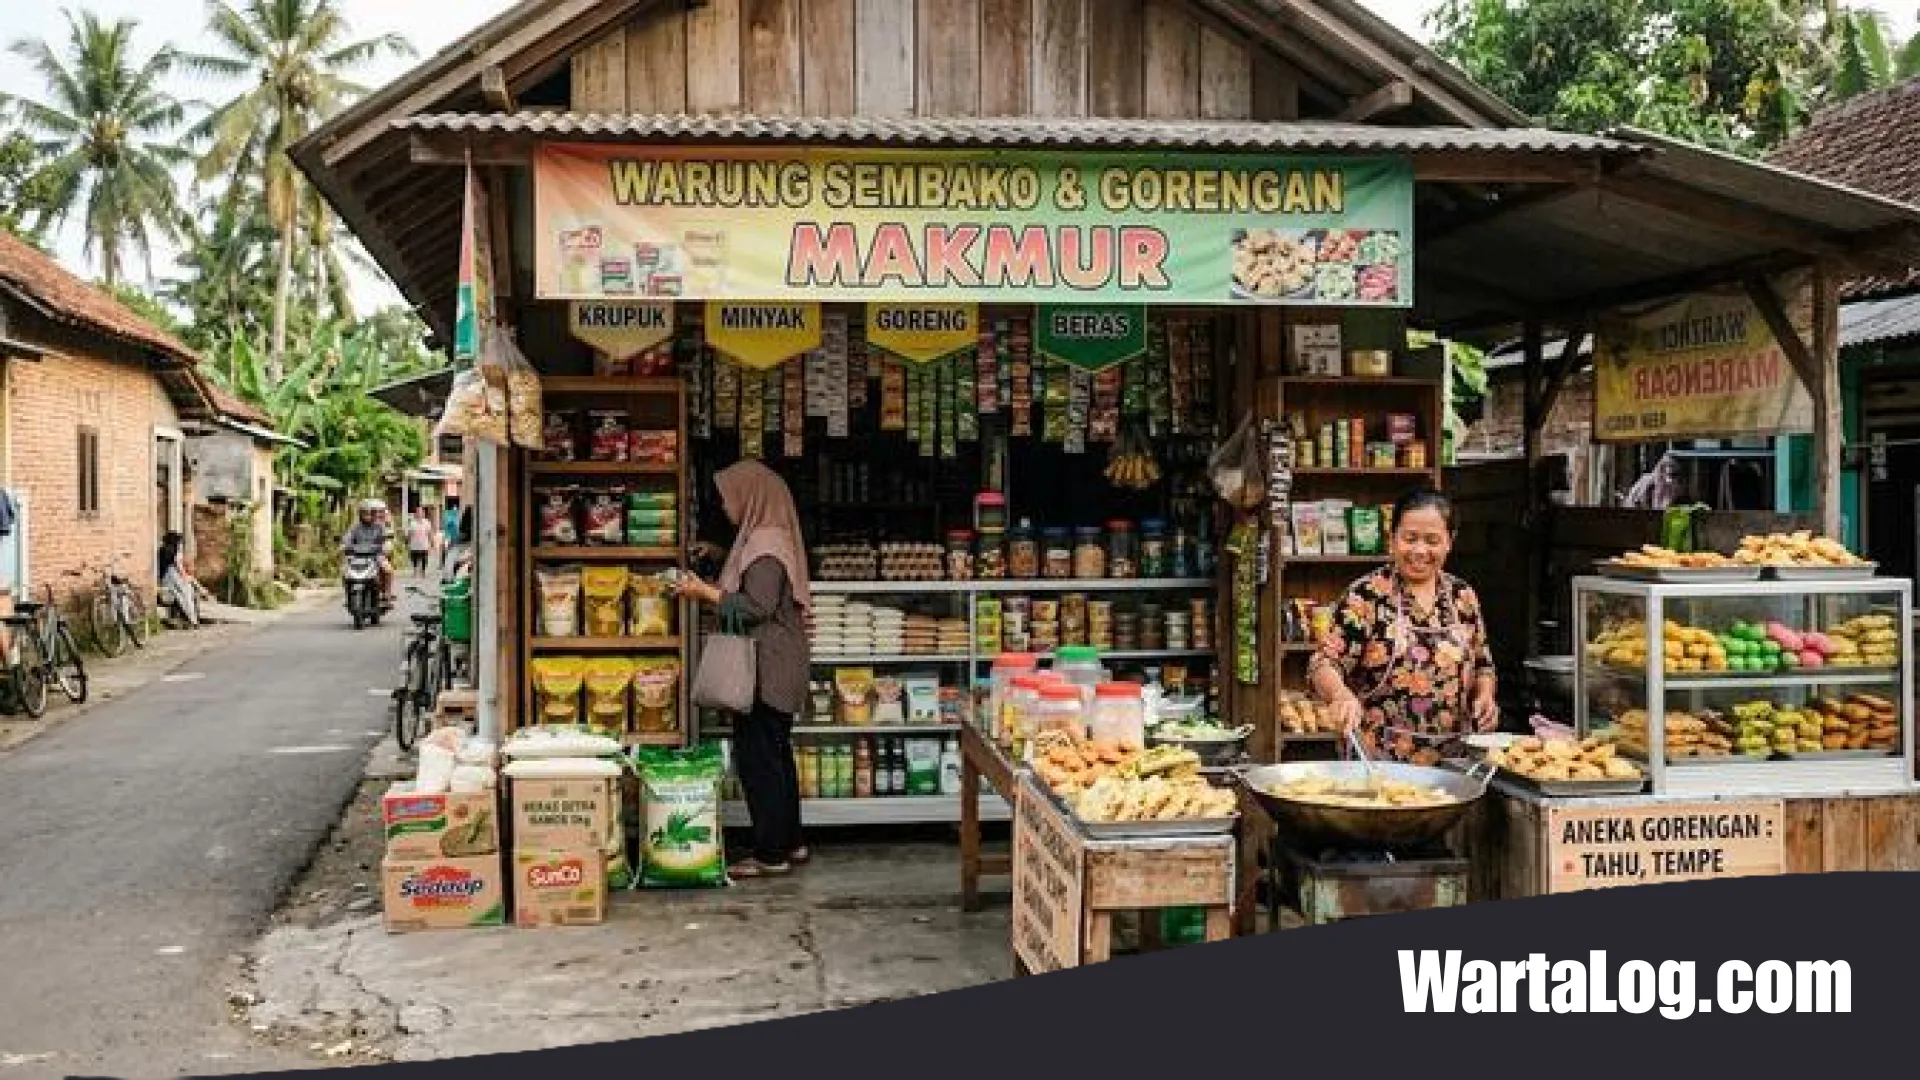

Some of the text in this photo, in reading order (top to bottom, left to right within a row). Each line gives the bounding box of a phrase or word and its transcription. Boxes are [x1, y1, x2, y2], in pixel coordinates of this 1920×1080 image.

[608, 160, 1345, 214] WARUNG SEMBAKO & GORENGAN
[785, 221, 1172, 291] MAKMUR
[578, 305, 666, 329] KRUPUK
[720, 306, 805, 330] MINYAK
[875, 306, 967, 331] GORENG
[1053, 312, 1129, 336] BERAS
[1562, 818, 1636, 845] ANEKA
[1640, 813, 1761, 843] GORENGAN
[1580, 848, 1725, 879] TAHU, TEMPE
